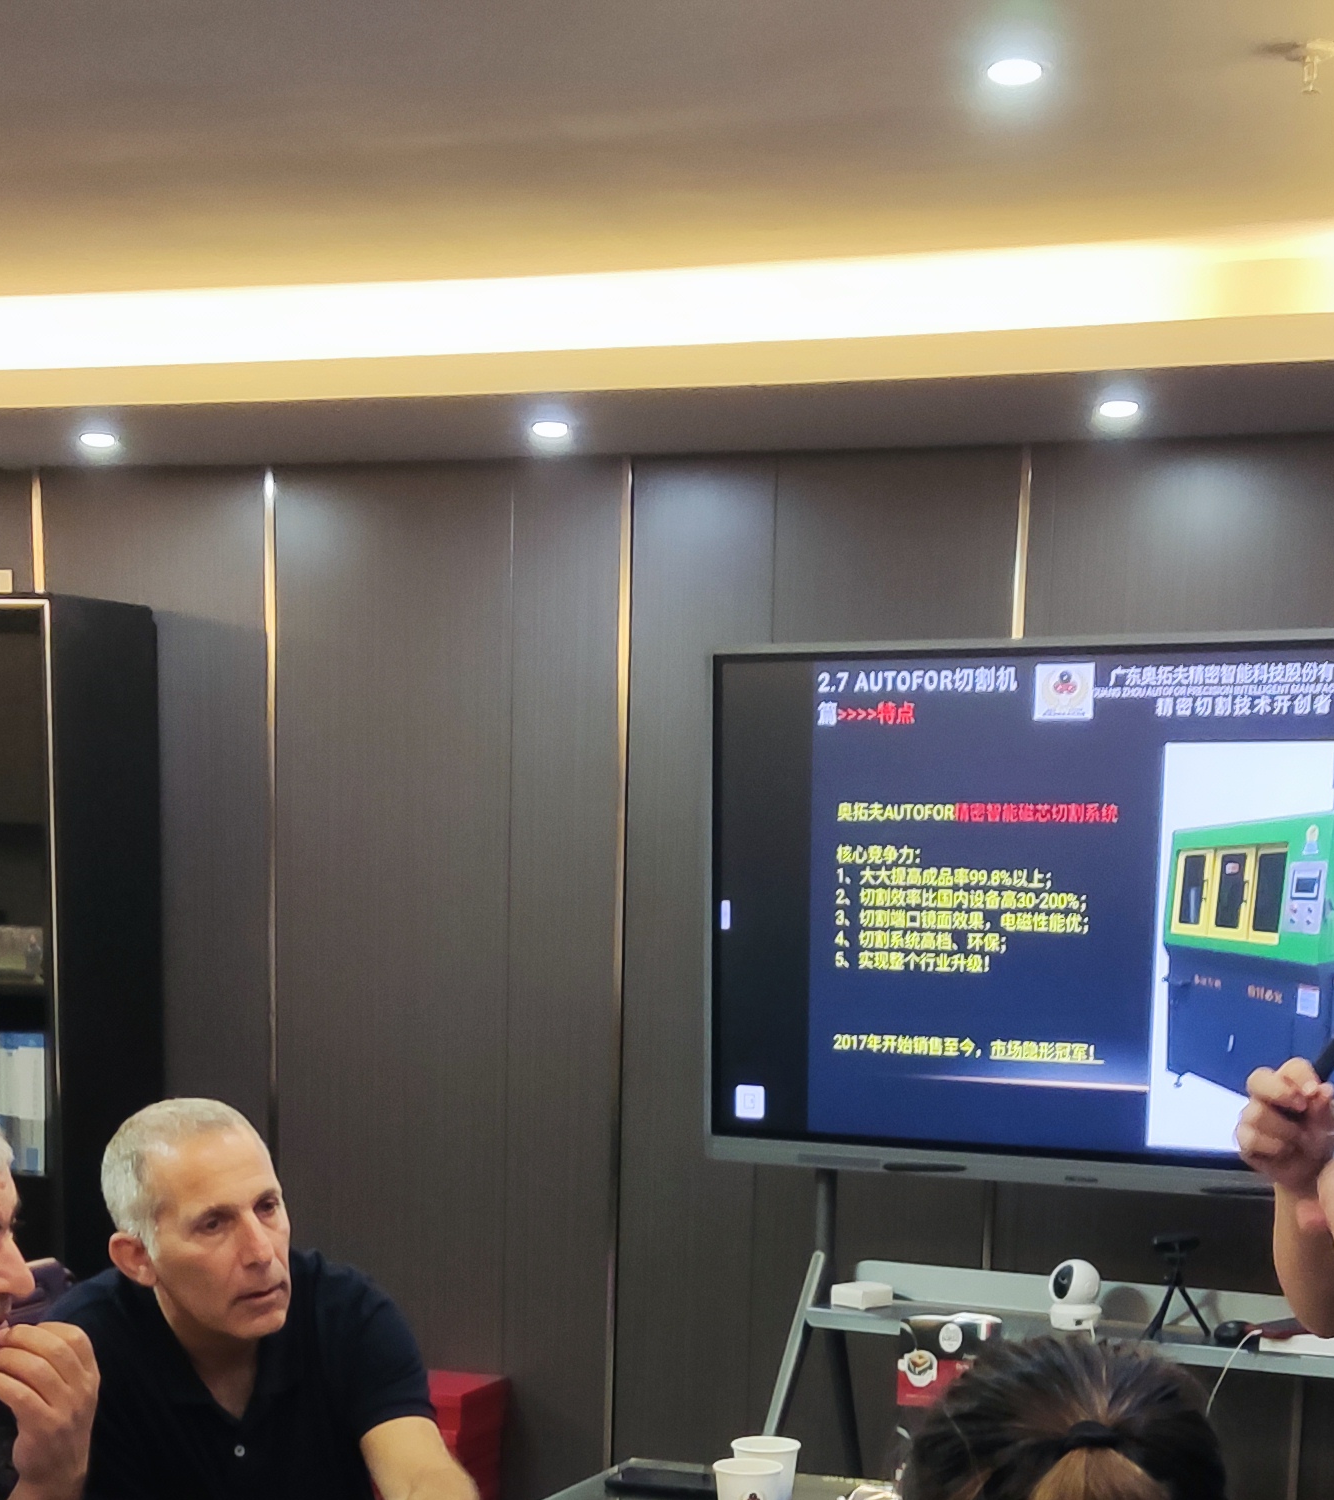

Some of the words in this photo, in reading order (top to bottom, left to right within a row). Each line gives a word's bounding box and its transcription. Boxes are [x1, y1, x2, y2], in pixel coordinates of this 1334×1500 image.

[817, 671, 849, 693] 2.7
[854, 666, 1017, 693] AUTOFOR切割机
[1155, 694, 1332, 717] 精密切割技术开创者
